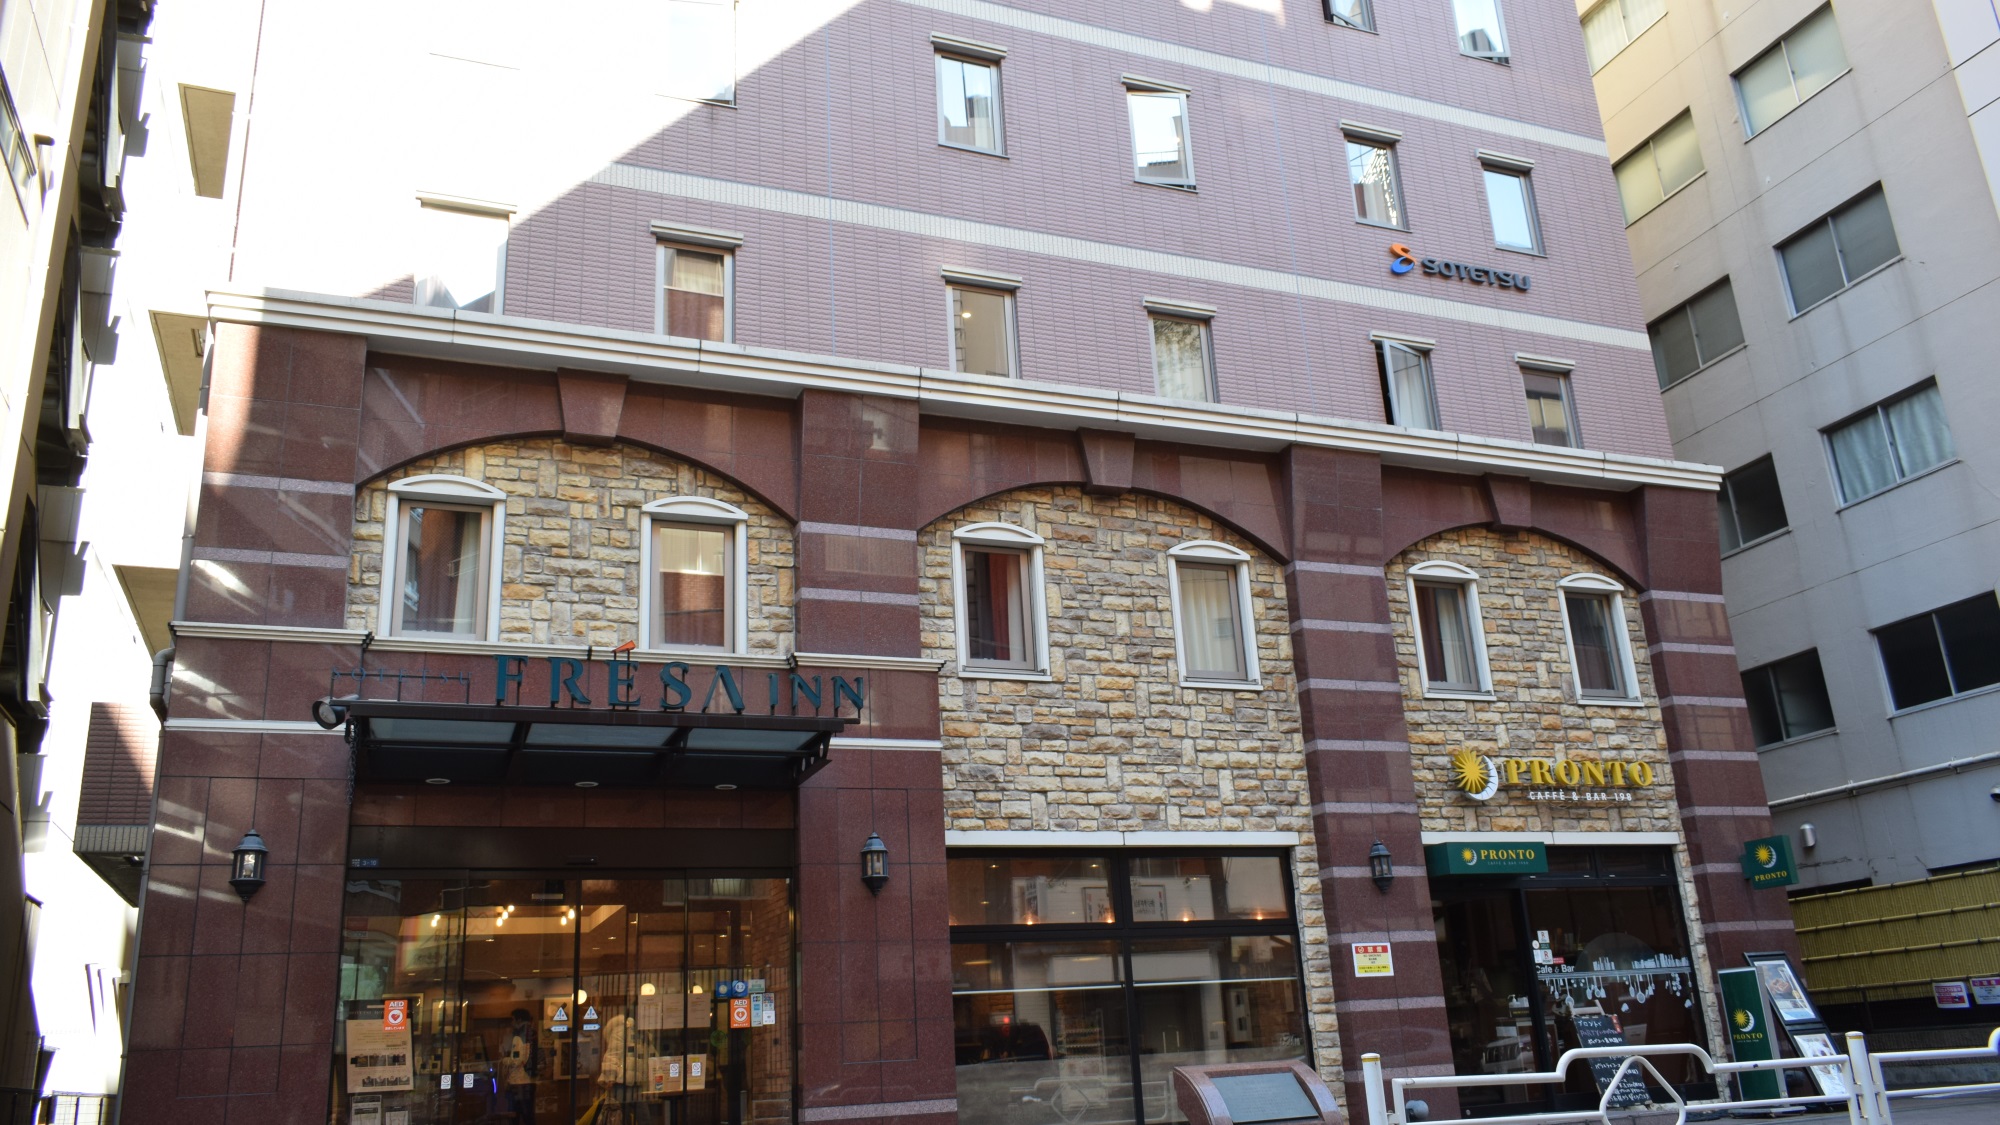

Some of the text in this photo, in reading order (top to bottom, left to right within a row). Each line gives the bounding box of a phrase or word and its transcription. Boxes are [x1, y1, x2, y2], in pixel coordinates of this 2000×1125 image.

[1421, 258, 1531, 291] SOTETSU
[331, 666, 472, 686] SOTETSU
[493, 654, 864, 713] FRESA INN
[1503, 759, 1653, 786] PRONTO
[1572, 791, 1579, 801] &
[1586, 792, 1607, 801] BAR
[1480, 849, 1535, 860] PRONTO
[1755, 870, 1787, 881] PRONTO
[1561, 964, 1575, 973] Bar
